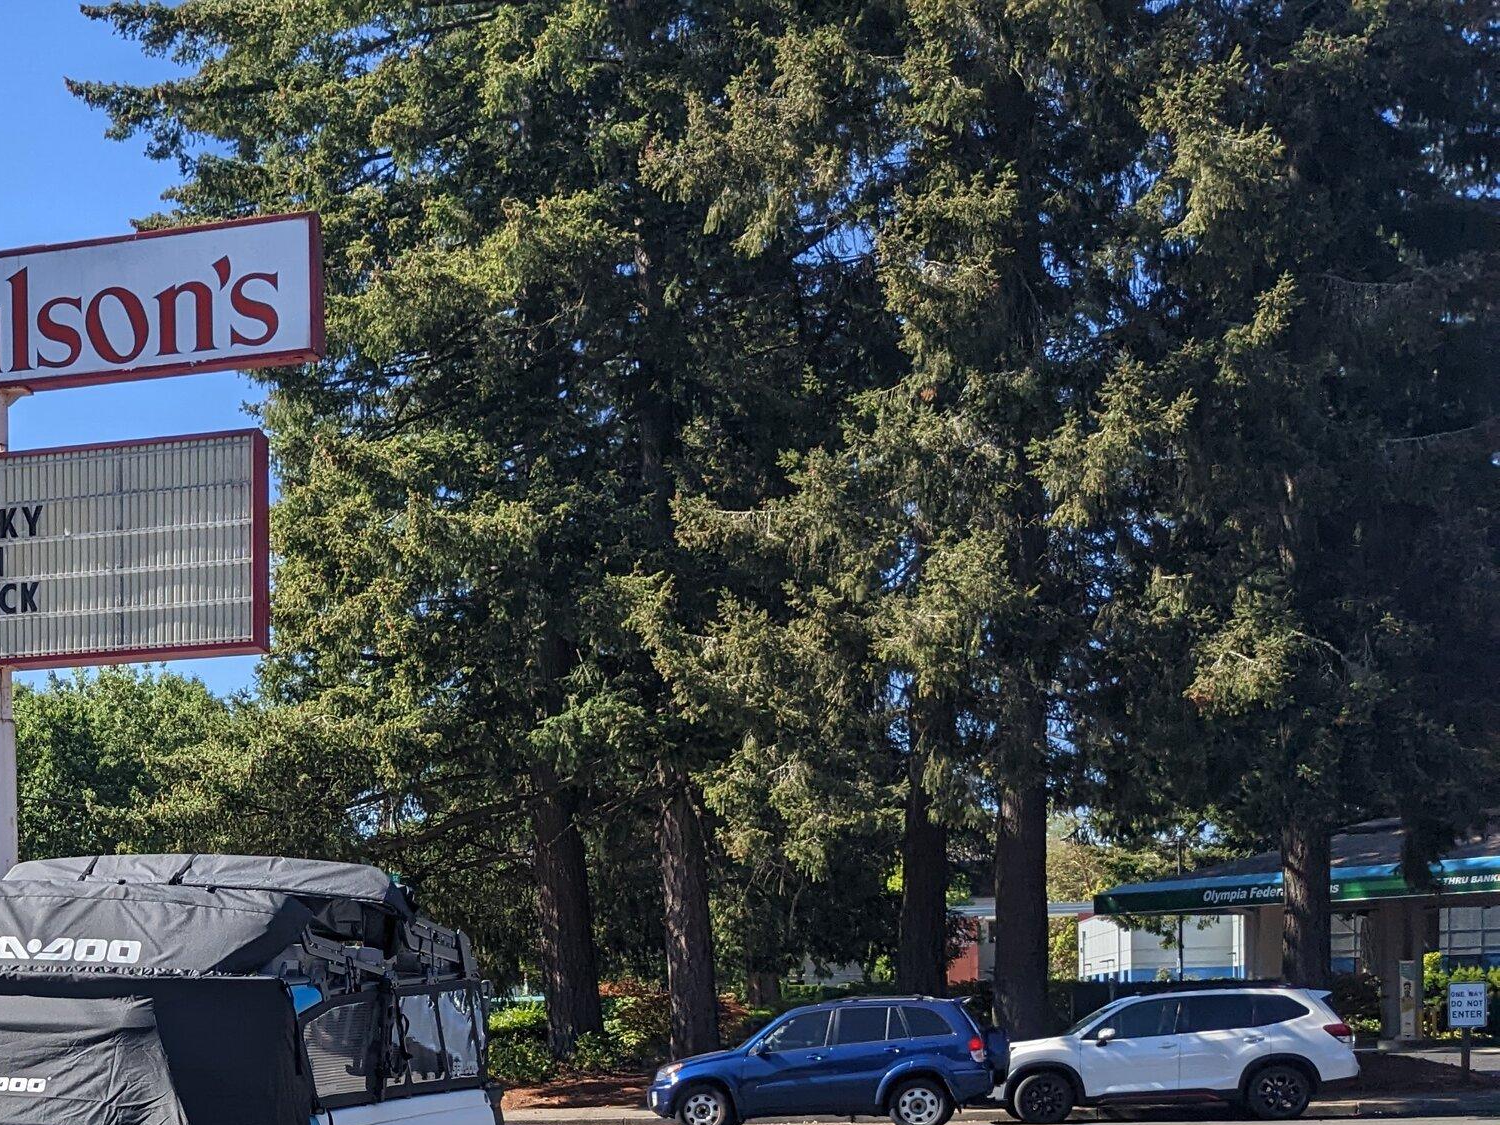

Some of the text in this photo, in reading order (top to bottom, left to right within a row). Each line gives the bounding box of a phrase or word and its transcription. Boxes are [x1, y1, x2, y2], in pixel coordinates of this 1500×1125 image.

[1443, 875, 1469, 886] THRU
[1203, 888, 1246, 904] Olympia
[1451, 1000, 1463, 1008] DO
[1452, 1010, 1483, 1019] ENTER
